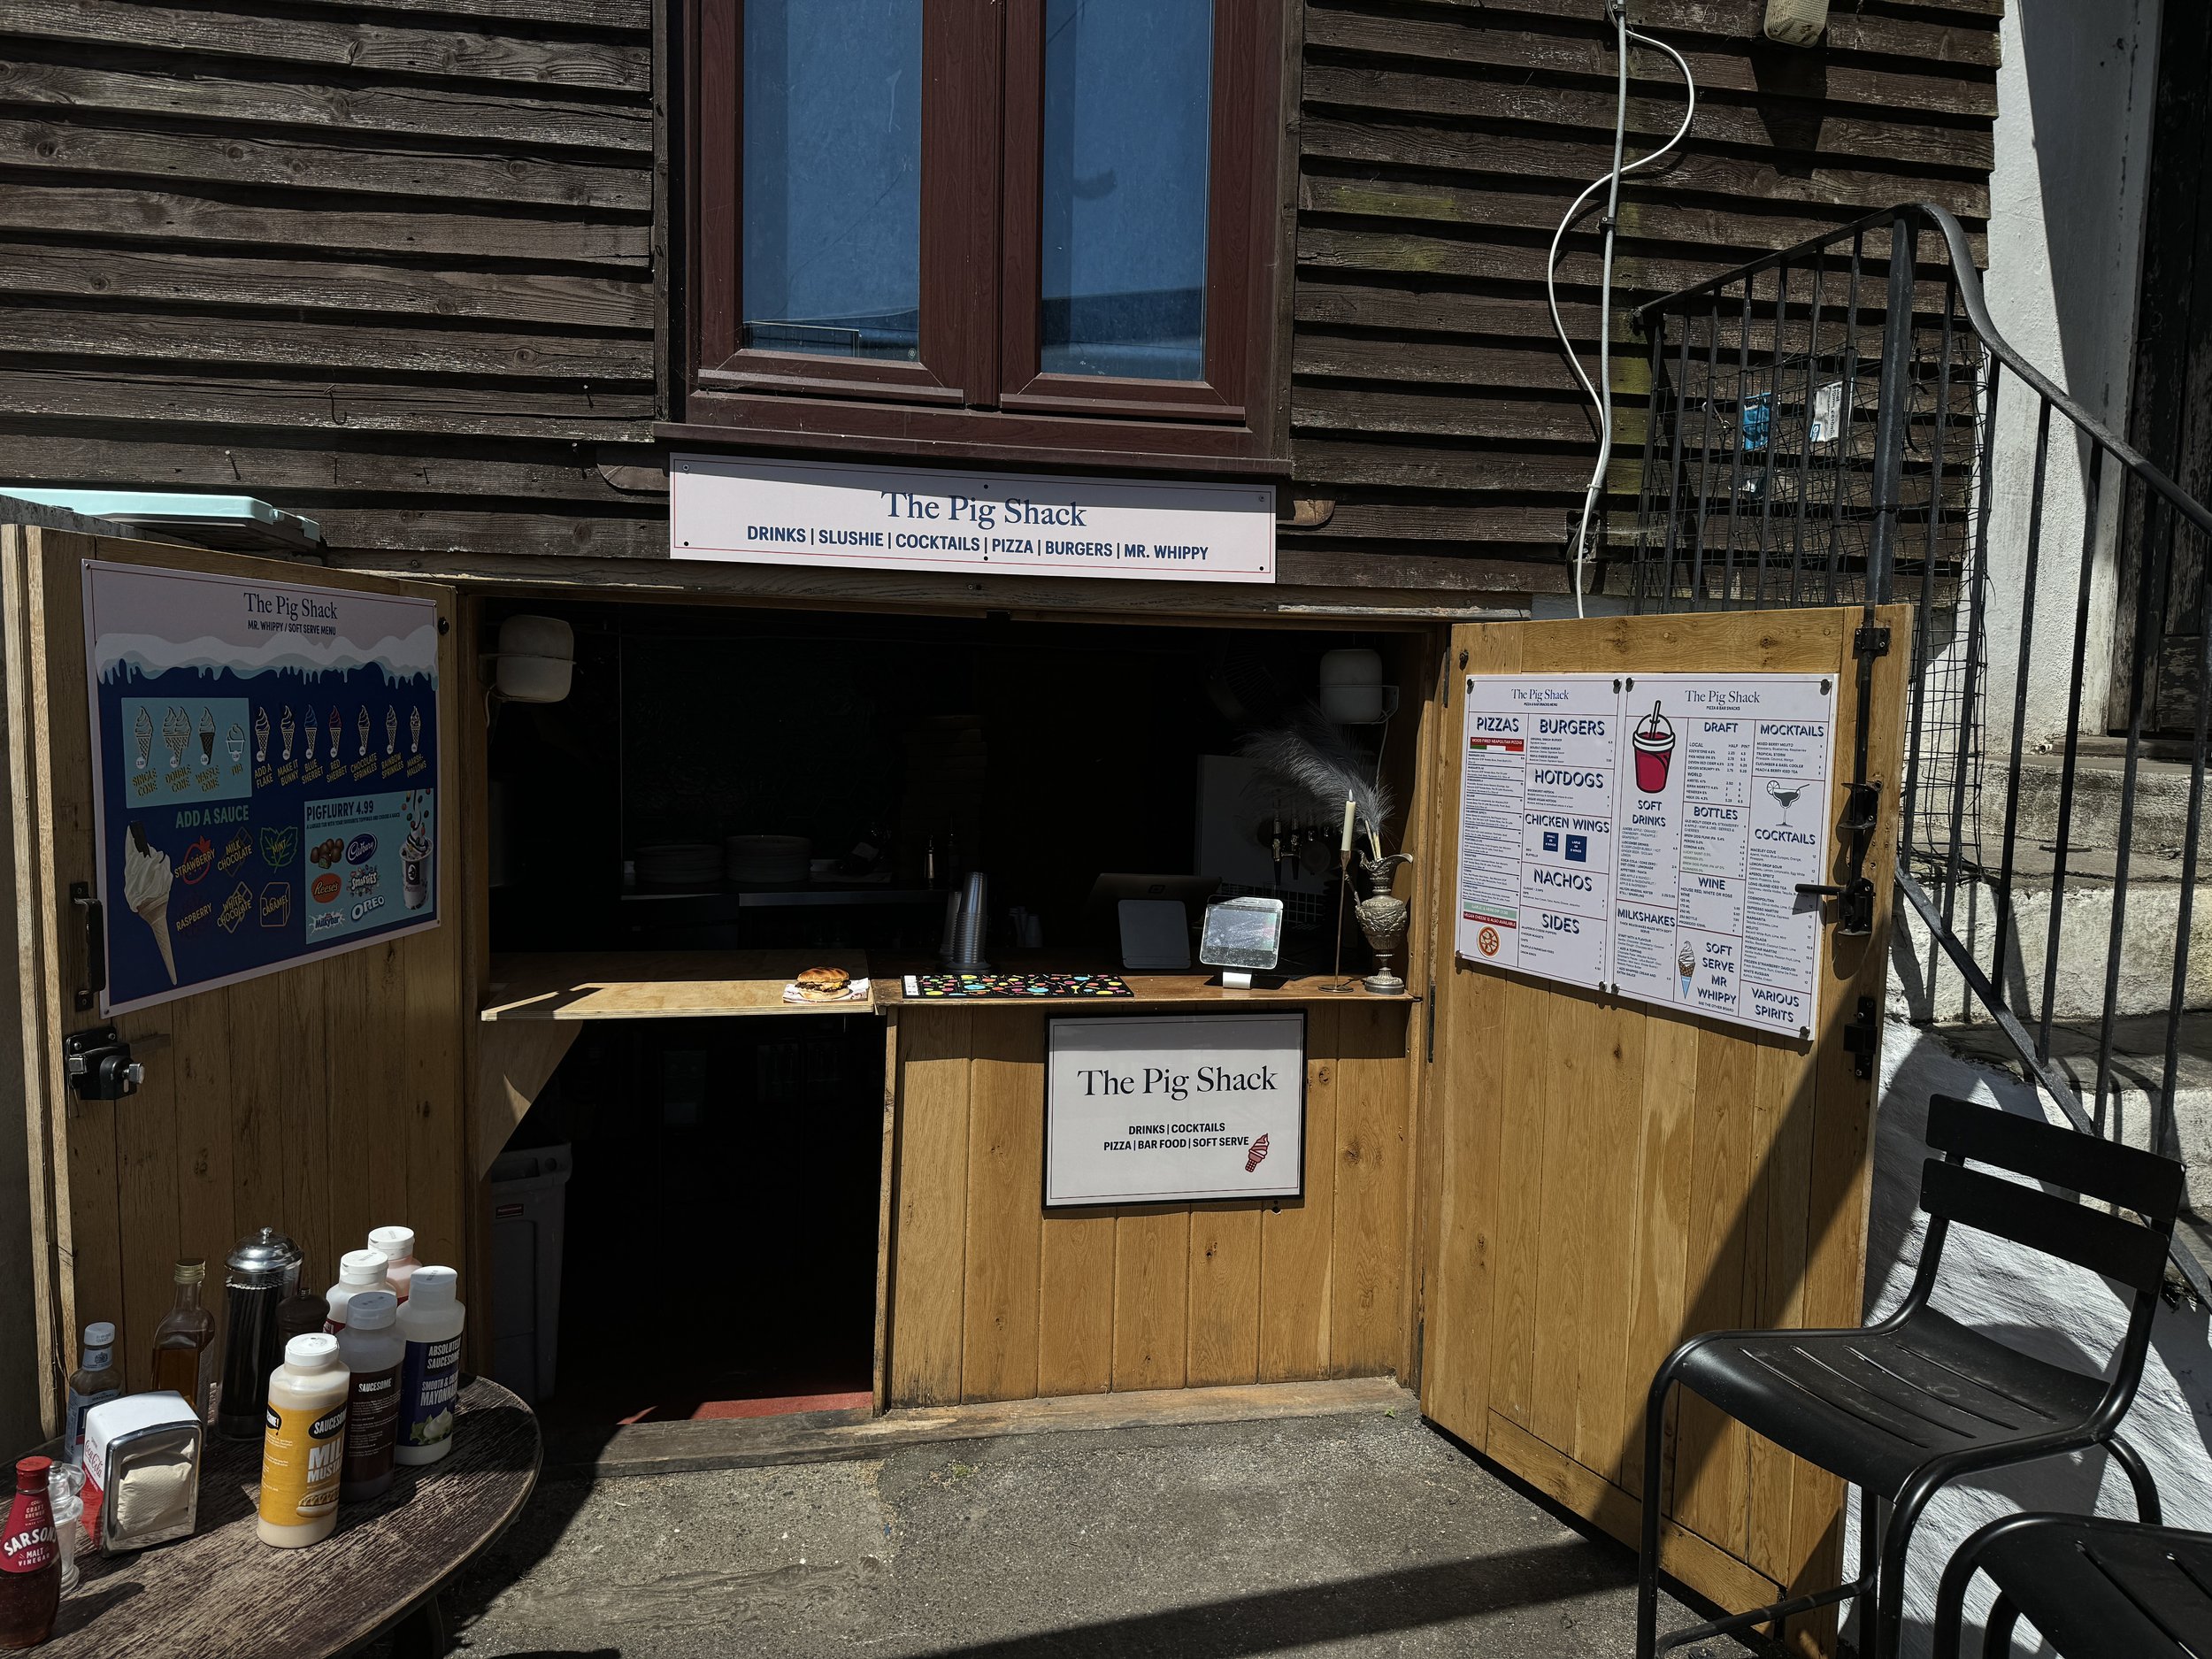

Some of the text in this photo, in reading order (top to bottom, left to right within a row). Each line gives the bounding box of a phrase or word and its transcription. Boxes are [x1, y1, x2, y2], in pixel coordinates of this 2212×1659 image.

[881, 489, 1087, 529] The Pig Shack
[747, 526, 1209, 560] DRINKS SLUSHIE COCKTAILS PIZZA BURGERS MR. WHIPPY
[243, 593, 338, 621] The Pig Shack
[247, 619, 259, 630] MR.
[260, 621, 283, 633] WHIPPY
[288, 623, 302, 633] SOFT
[303, 624, 319, 634] SERVE
[321, 626, 336, 635] MENU
[1511, 688, 1569, 702] The Pig Shack
[1685, 690, 1760, 706] The Pig Shack
[1477, 717, 1519, 733] PIZZAS
[1540, 718, 1605, 736] BURGERS
[1704, 722, 1739, 733] DRAFT
[1760, 724, 1824, 737] MOCKTAILS
[277, 758, 299, 777] MAKE IT
[304, 758, 318, 772] BLUE
[330, 758, 341, 771] RED
[350, 752, 377, 772] CHOCOLATE
[381, 752, 402, 769] RAINBOW
[133, 768, 157, 787] SINGLE
[165, 764, 191, 784] DOUBLE
[254, 763, 273, 779] ADD A
[280, 769, 299, 786] BUNNY
[301, 765, 324, 784] SHERBET
[326, 764, 348, 783] SHERBET
[354, 762, 377, 781] SPRINKLES
[381, 761, 404, 780] SPRINKLES
[1535, 769, 1604, 789] HOTDOGS
[256, 772, 273, 789] FLAKE
[306, 800, 374, 821] PIGFLURRY 4.99
[1638, 800, 1663, 811] SOFT
[1694, 806, 1738, 820] BOTTLES
[175, 804, 250, 829] ADD A SAUCE
[1525, 813, 1569, 829] CHICKEN
[1572, 818, 1609, 833] WINGS
[1632, 814, 1666, 827] DRINKS
[1755, 828, 1816, 845] COCKTAILS
[226, 840, 241, 856] MILK
[272, 839, 287, 854] MINT
[347, 841, 374, 861] Cadbury
[174, 848, 215, 879] STRAWBERRY
[217, 844, 253, 871] CHOCOLATE
[1533, 868, 1593, 892] NACHOS
[1698, 877, 1725, 890] WINE
[222, 891, 243, 911] WHITE
[262, 895, 288, 917] CARAMEL
[351, 895, 385, 920] OREO
[176, 902, 212, 932] RASPBERRY
[217, 900, 252, 927] CHOCOLATE
[315, 916, 340, 928] Milkybar
[1617, 908, 1676, 927] MILKSHAKES
[1540, 913, 1580, 934] SIDES
[1706, 942, 1732, 956] SOFT
[1702, 957, 1735, 973] SERVE
[1711, 974, 1727, 987] MR
[1697, 987, 1737, 1005] WHIPPY
[1751, 987, 1800, 1008] VARIOUS
[1755, 1004, 1794, 1023] SPIRITS
[1077, 1065, 1279, 1101] The Pig Shack
[1128, 1123, 1225, 1135] DRINKS COCKTAILS
[1103, 1136, 1249, 1151] PIZZA BAR FOOD SOFT SERVE
[358, 1378, 392, 1393] SAUCESOME
[421, 1378, 443, 1391] SMOOTH
[443, 1377, 449, 1386] &
[308, 1438, 342, 1470] MIL
[26, 1504, 44, 1513] CRAFT
[4, 1526, 57, 1556] SARSONS
[18, 1553, 50, 1567] VINEGAR
[27, 1548, 44, 1559] MALT
